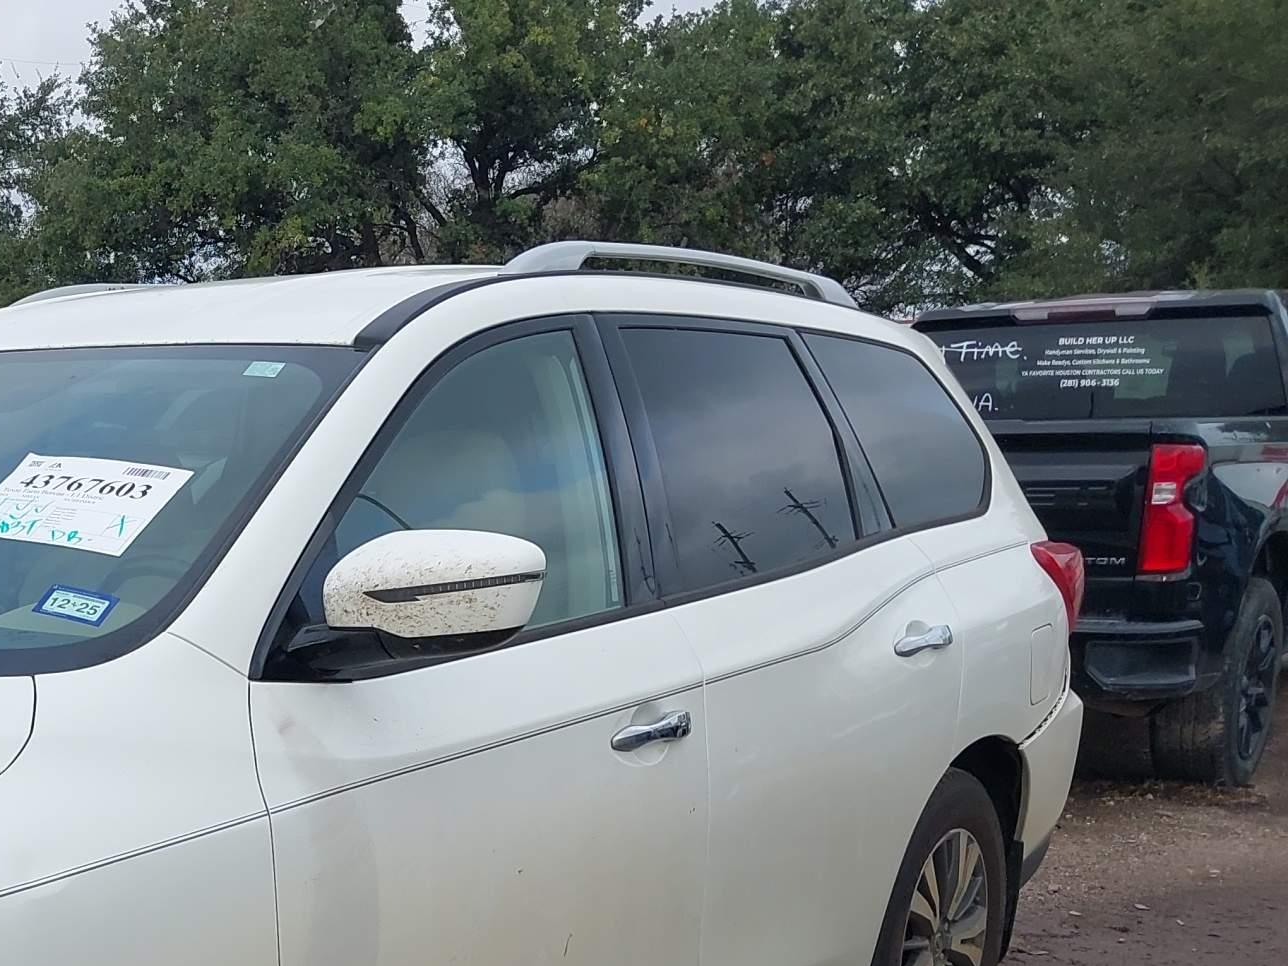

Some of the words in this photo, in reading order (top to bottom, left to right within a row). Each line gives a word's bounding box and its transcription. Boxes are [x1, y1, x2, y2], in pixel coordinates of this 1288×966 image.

[1058, 337, 1085, 346] BUILD
[1086, 336, 1104, 345] HER
[1105, 336, 1117, 345] UP
[1119, 335, 1135, 344] LLC
[1044, 349, 1073, 357] Handyman
[1097, 347, 1117, 355] Drywall
[1123, 347, 1146, 355] Painting
[1081, 368, 1121, 376] CONTRACTORS
[1145, 367, 1165, 375] TODAY
[1059, 378, 1079, 389] (281)
[20, 473, 153, 500] 43767603
[1084, 556, 1126, 565] TOM
